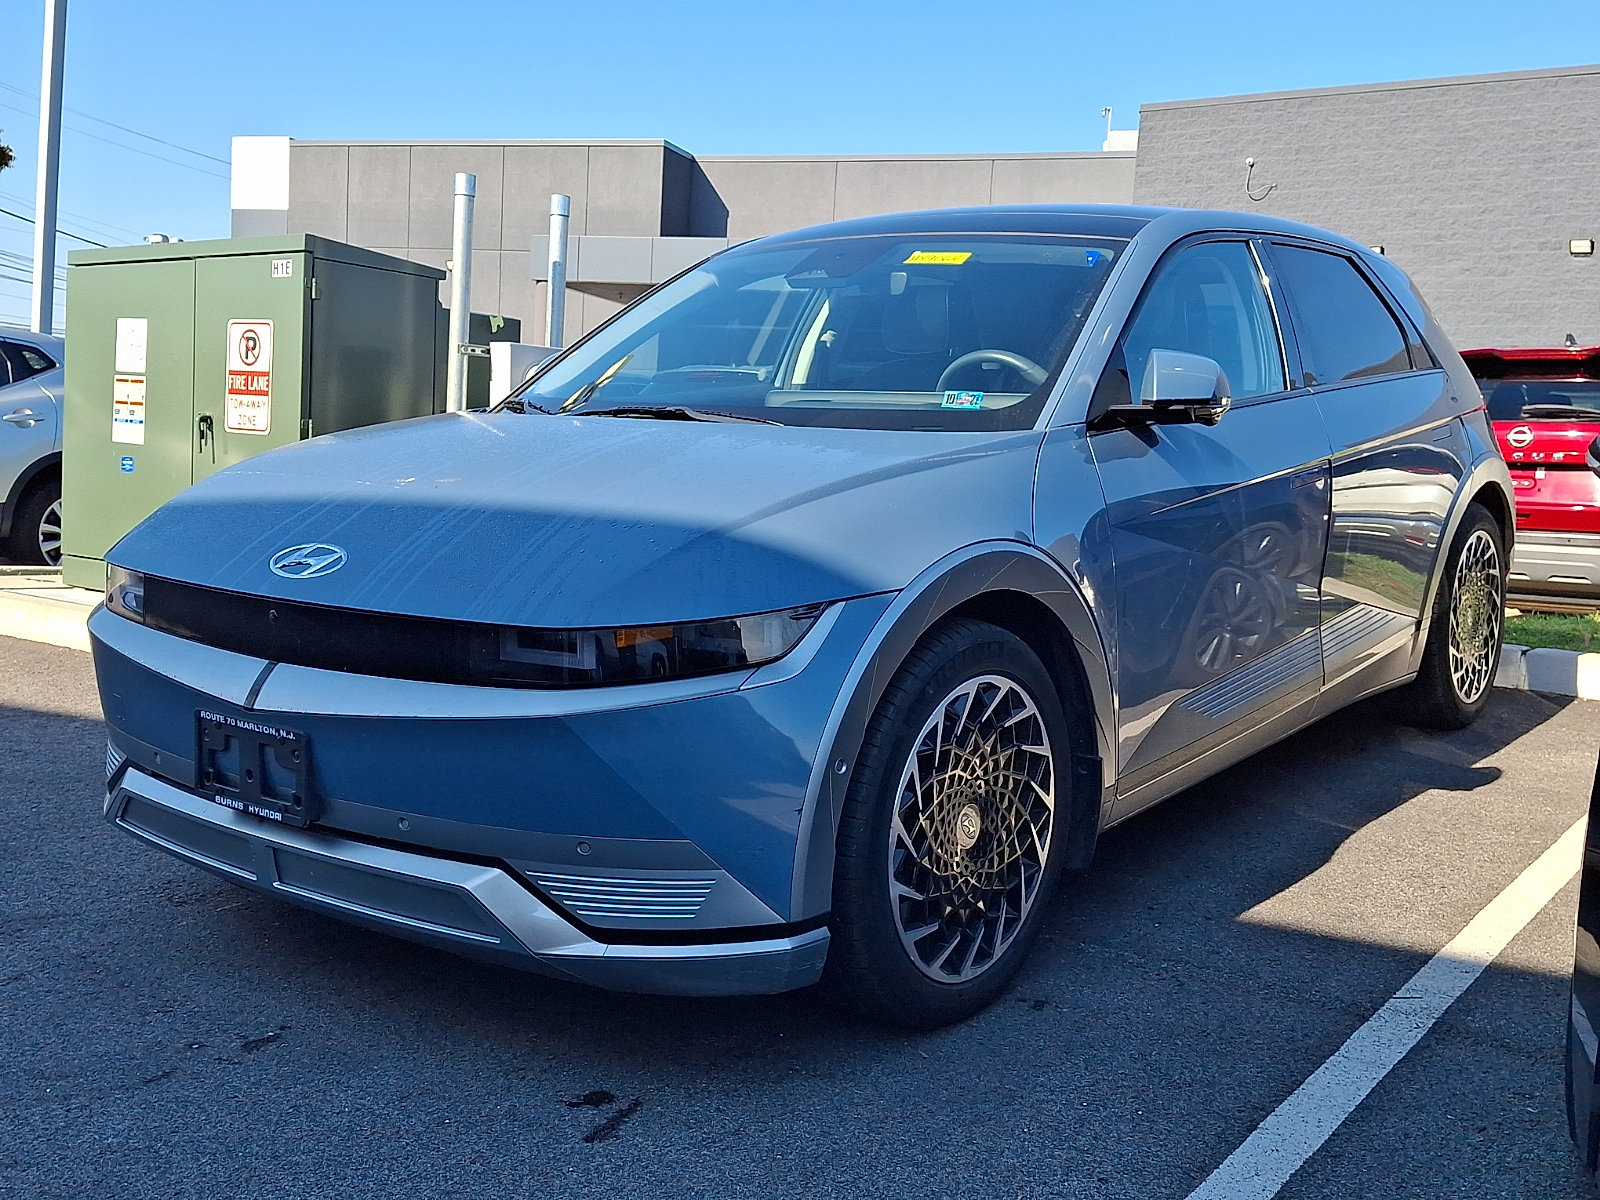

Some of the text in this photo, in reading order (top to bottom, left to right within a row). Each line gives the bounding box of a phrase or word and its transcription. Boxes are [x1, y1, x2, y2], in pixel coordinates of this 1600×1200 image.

[273, 261, 291, 275] H1E
[229, 374, 269, 391] FIRE LANE
[230, 398, 266, 410] TOW-AWAY
[945, 393, 956, 405] 10
[238, 414, 257, 426] ZONE
[200, 710, 296, 740] ROUTE 70 MARLTON, N.J.
[215, 795, 282, 821] BURNS HYUNDAI
